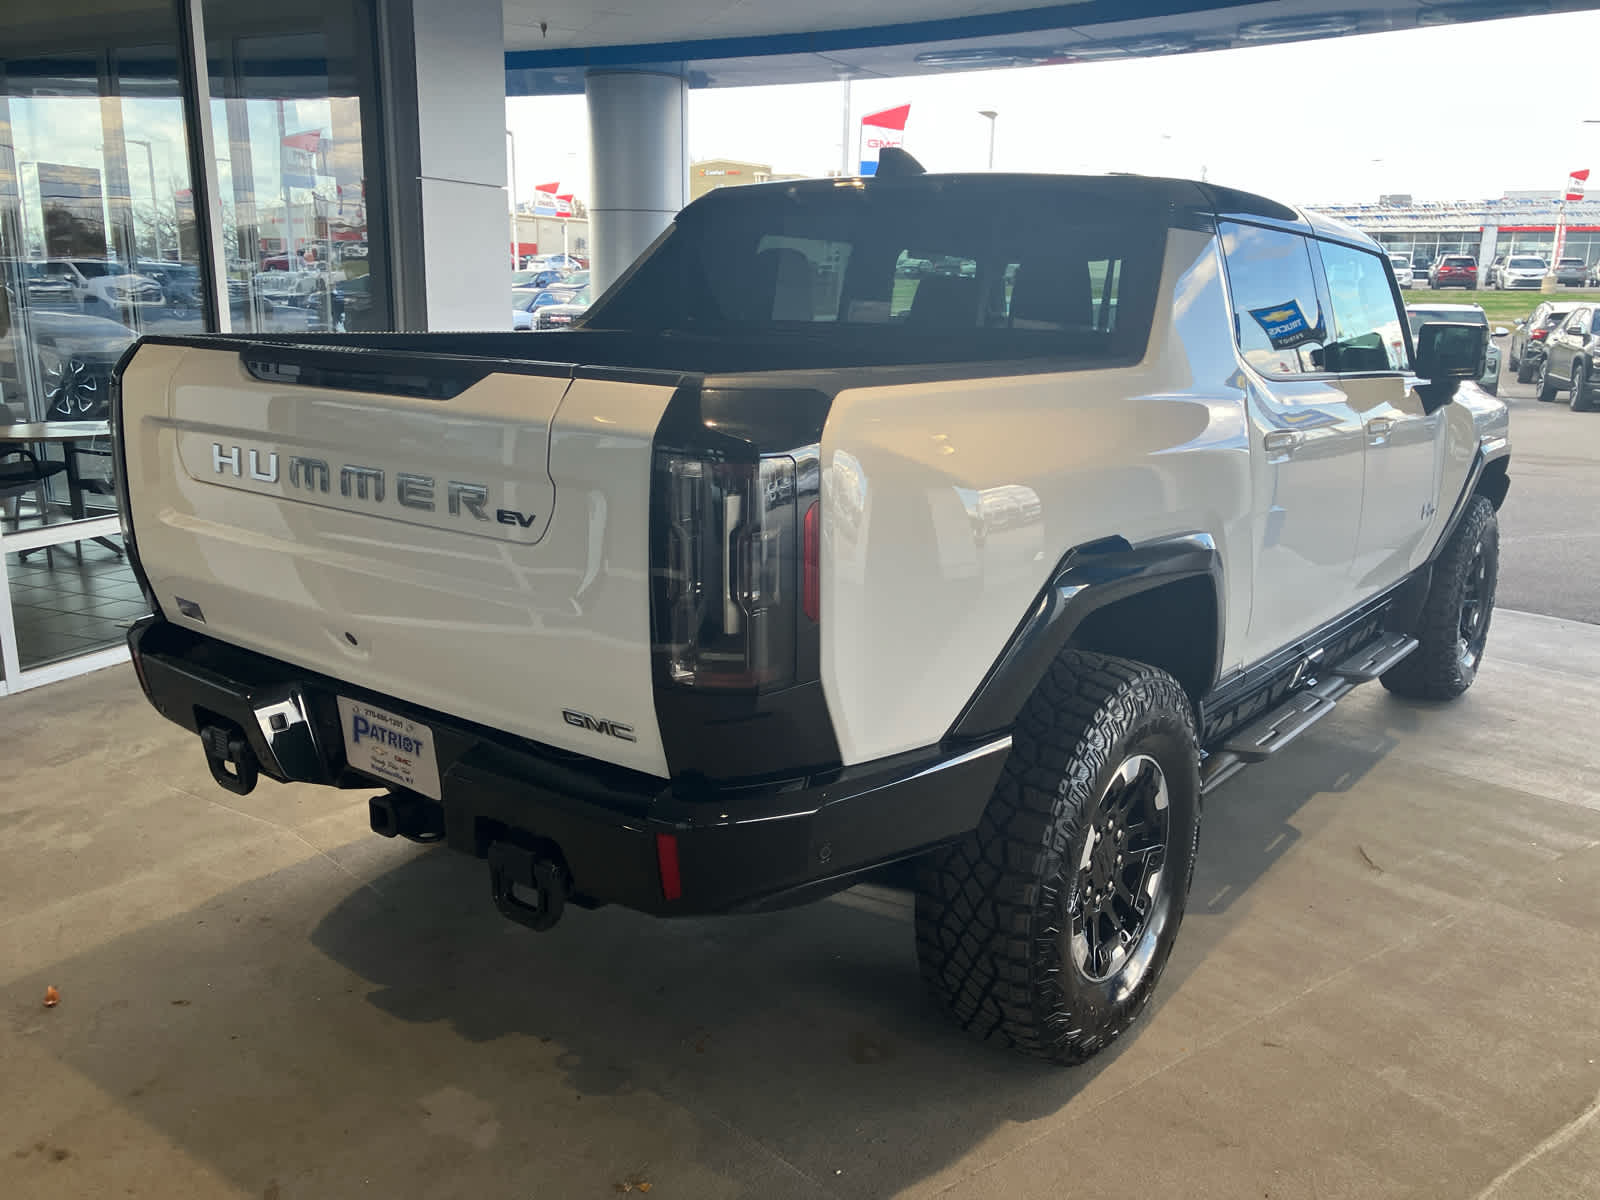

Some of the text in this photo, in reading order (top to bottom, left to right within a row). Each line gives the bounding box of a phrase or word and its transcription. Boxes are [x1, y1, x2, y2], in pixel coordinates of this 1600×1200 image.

[211, 442, 536, 528] HUMMER EV
[352, 714, 423, 758] PATRIOT
[562, 708, 637, 743] GMC
